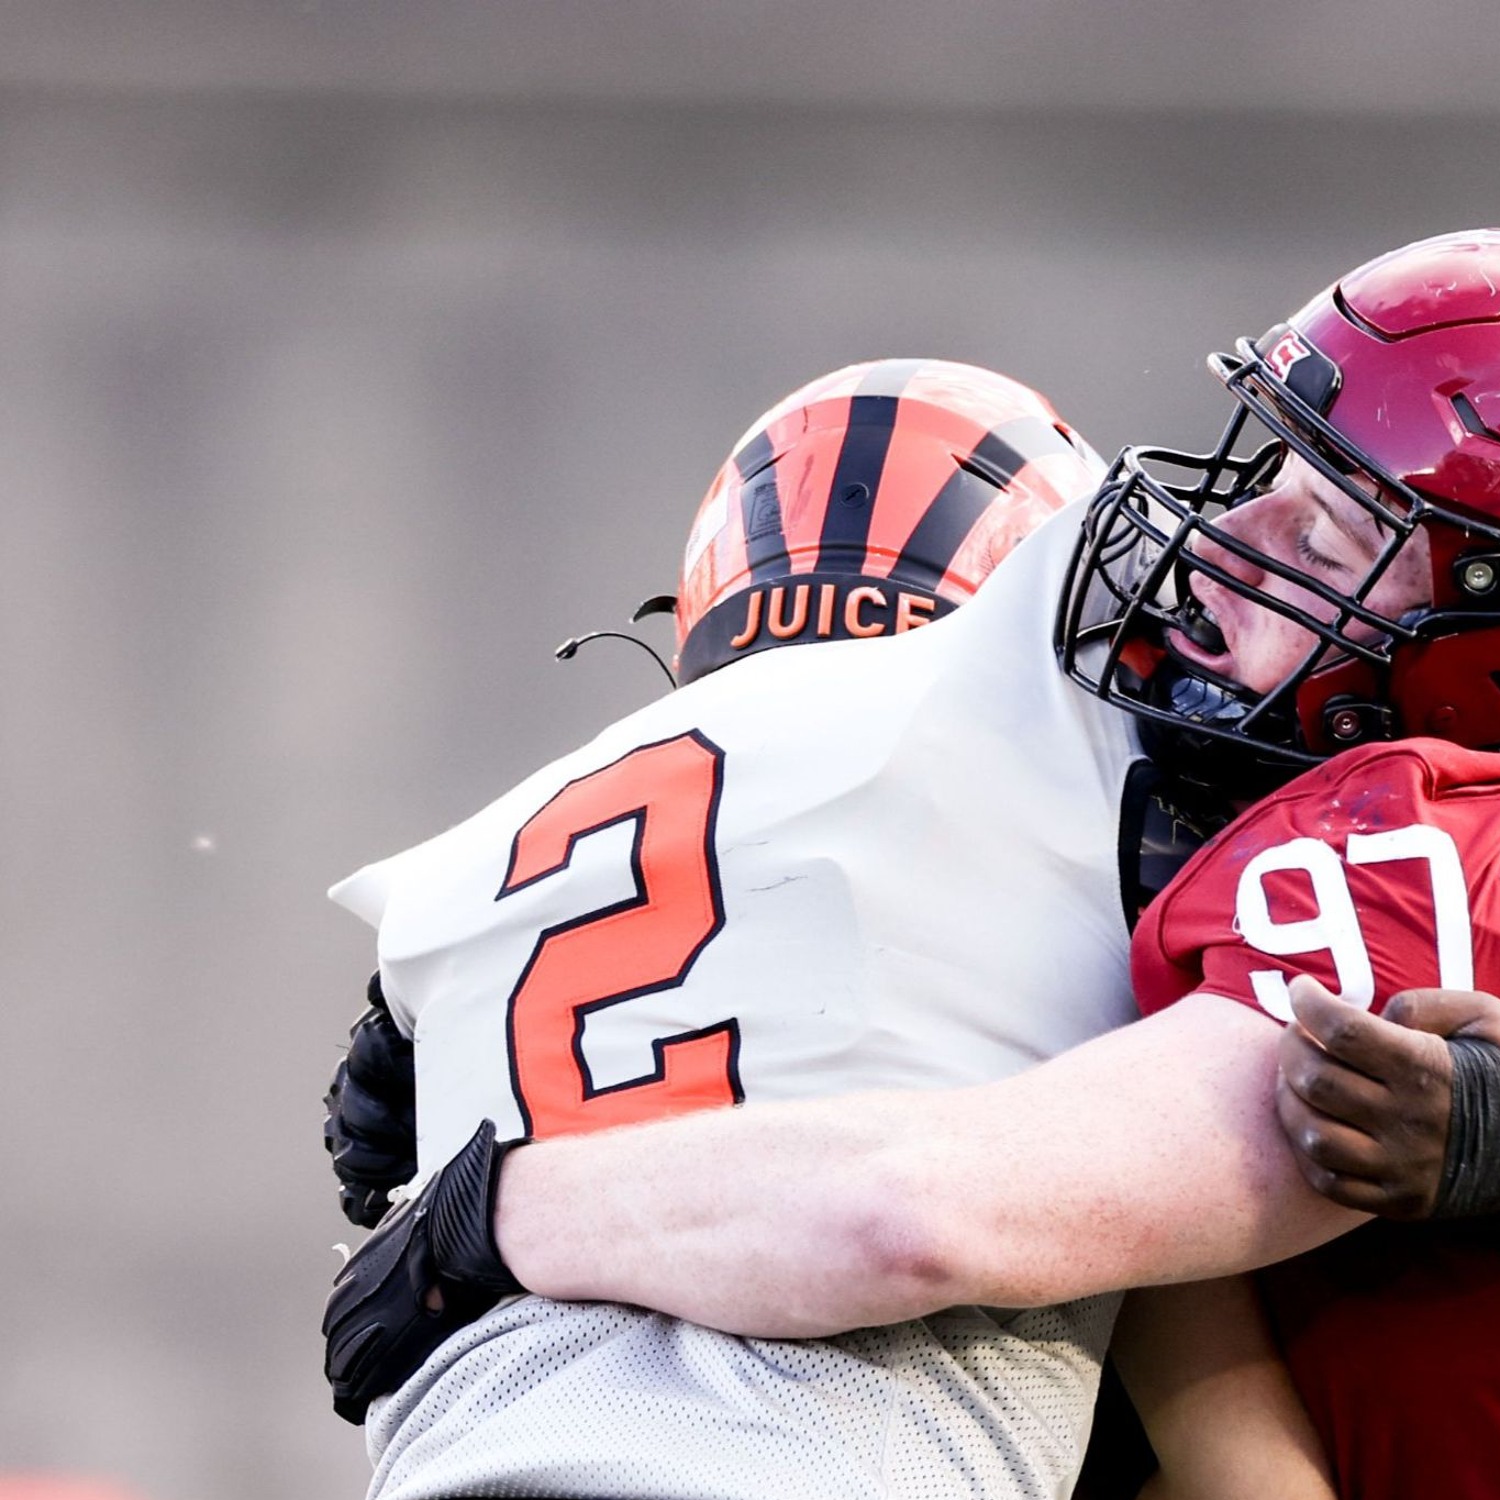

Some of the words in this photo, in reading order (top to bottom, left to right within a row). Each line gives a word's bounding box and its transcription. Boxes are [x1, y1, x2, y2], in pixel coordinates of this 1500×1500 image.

[729, 583, 935, 648] JUICE
[493, 727, 746, 1143] 2
[1233, 823, 1475, 1024] 97
